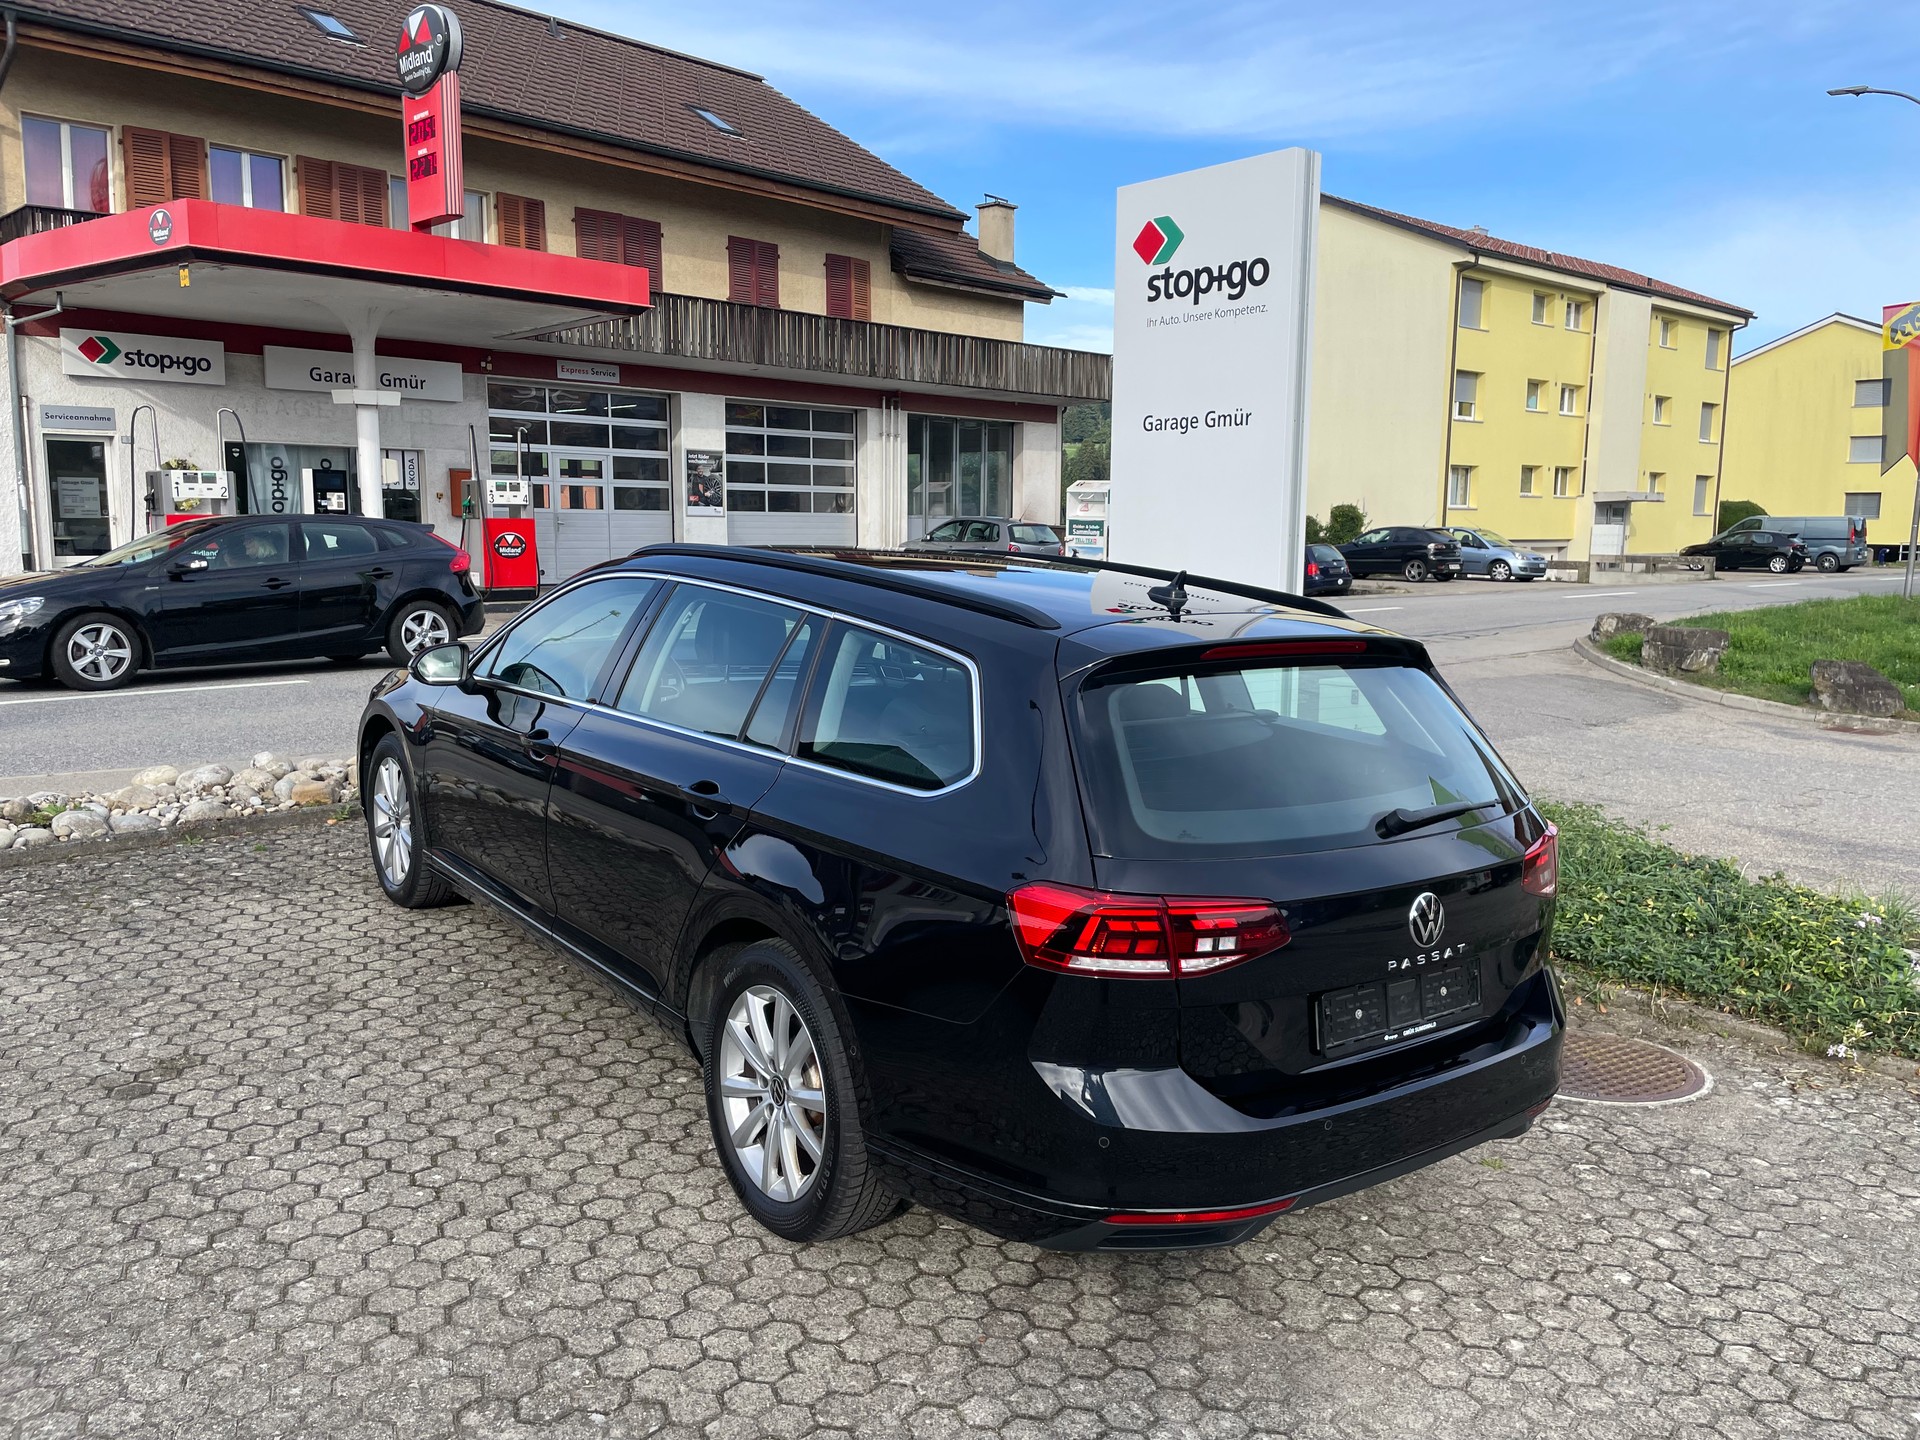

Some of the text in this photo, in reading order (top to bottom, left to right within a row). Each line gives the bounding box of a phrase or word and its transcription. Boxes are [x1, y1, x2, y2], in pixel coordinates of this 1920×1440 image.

[399, 45, 433, 75] Midland
[1147, 257, 1270, 305] stop+go
[1146, 303, 1269, 328] Ihr Auto. Unsere Kompetenz.
[124, 349, 212, 376] stop+go
[560, 365, 617, 379] Express Service
[309, 366, 426, 390] Gara Gmür
[45, 412, 112, 422] Serviceannahme
[1143, 408, 1252, 434] Garage Gmür
[270, 456, 288, 513] op+go
[408, 457, 416, 486] ŠKODA
[174, 486, 228, 498] 1 2
[489, 493, 528, 504] 3 4
[1387, 943, 1466, 971] PASSAT
